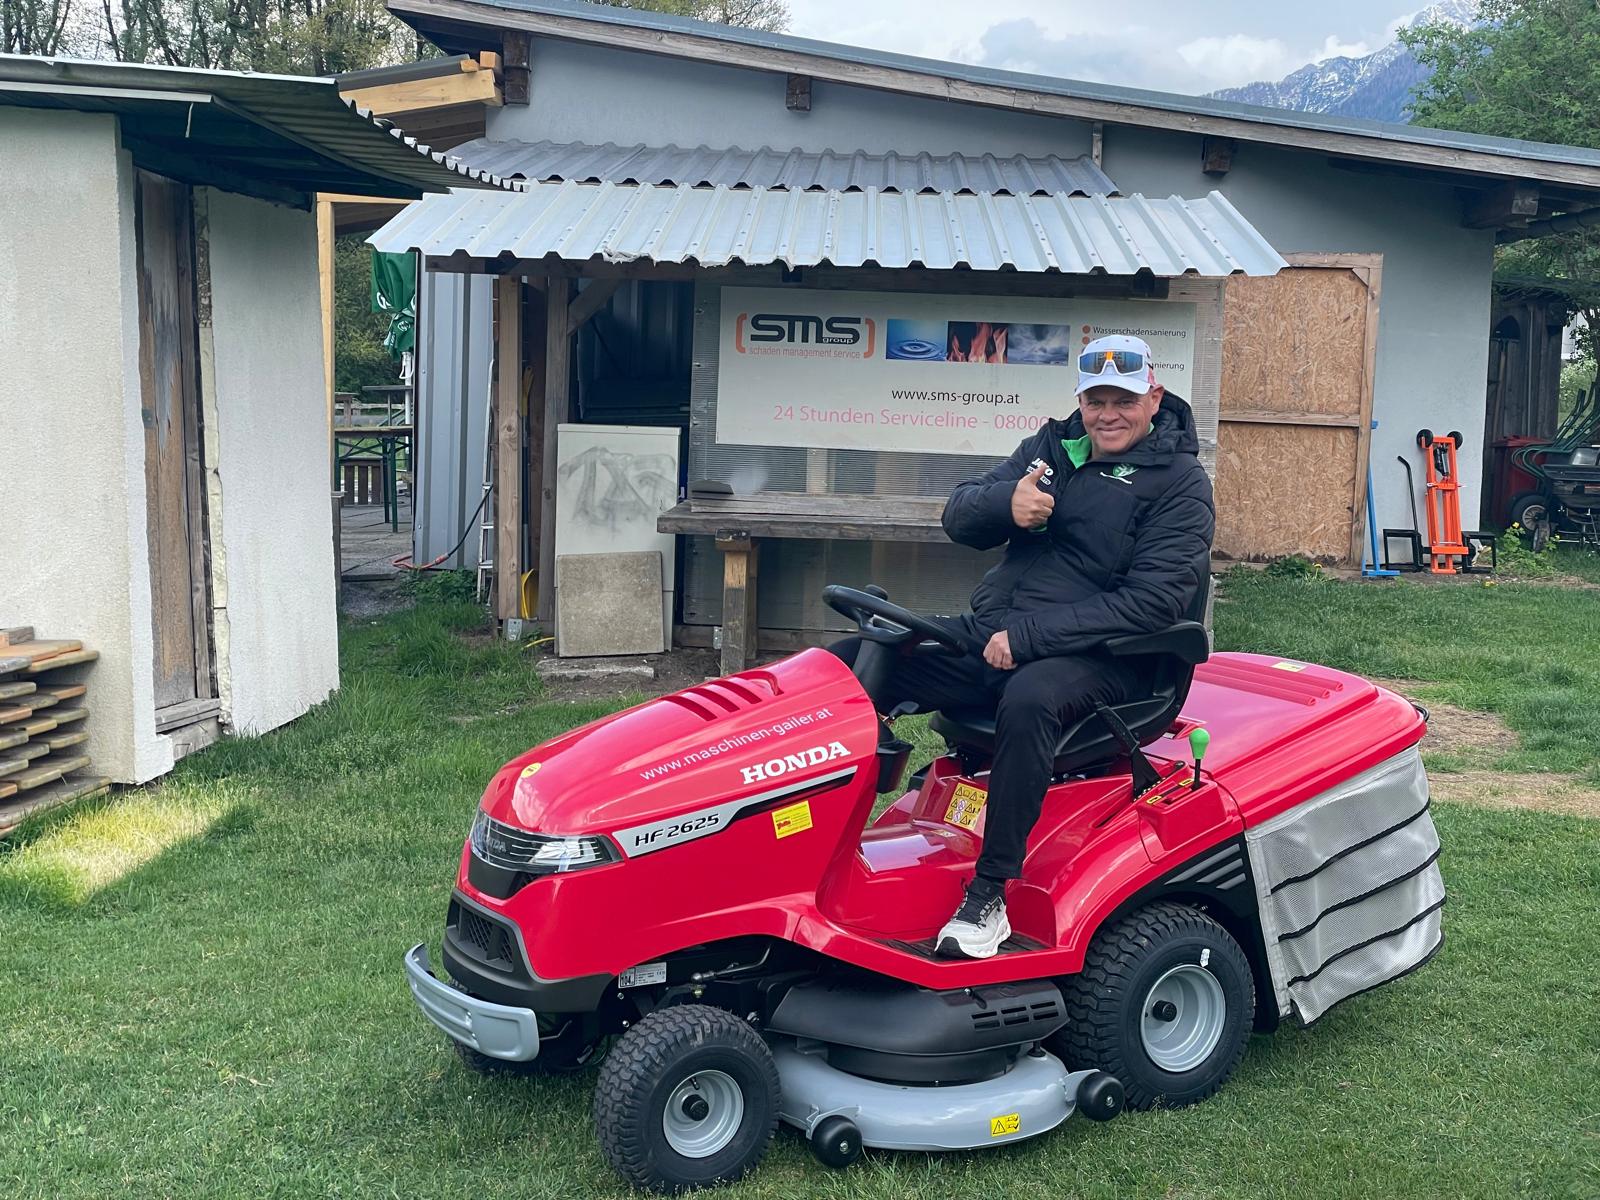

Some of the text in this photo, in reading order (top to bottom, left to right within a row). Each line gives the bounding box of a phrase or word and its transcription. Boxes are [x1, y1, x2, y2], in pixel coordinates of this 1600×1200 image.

[822, 337, 854, 345] group
[1093, 326, 1187, 338] Wasserschadensanierung
[750, 346, 861, 359] schaden management service
[891, 389, 1020, 406] www.sms-group.at
[773, 405, 794, 421] 24
[799, 405, 874, 424] Stunden
[880, 409, 978, 429] Serviceline
[1031, 457, 1054, 476] JAO
[639, 707, 834, 782] www.maschinen-gailer.at
[739, 741, 851, 785] HONDA
[634, 813, 720, 847] HF 2625
